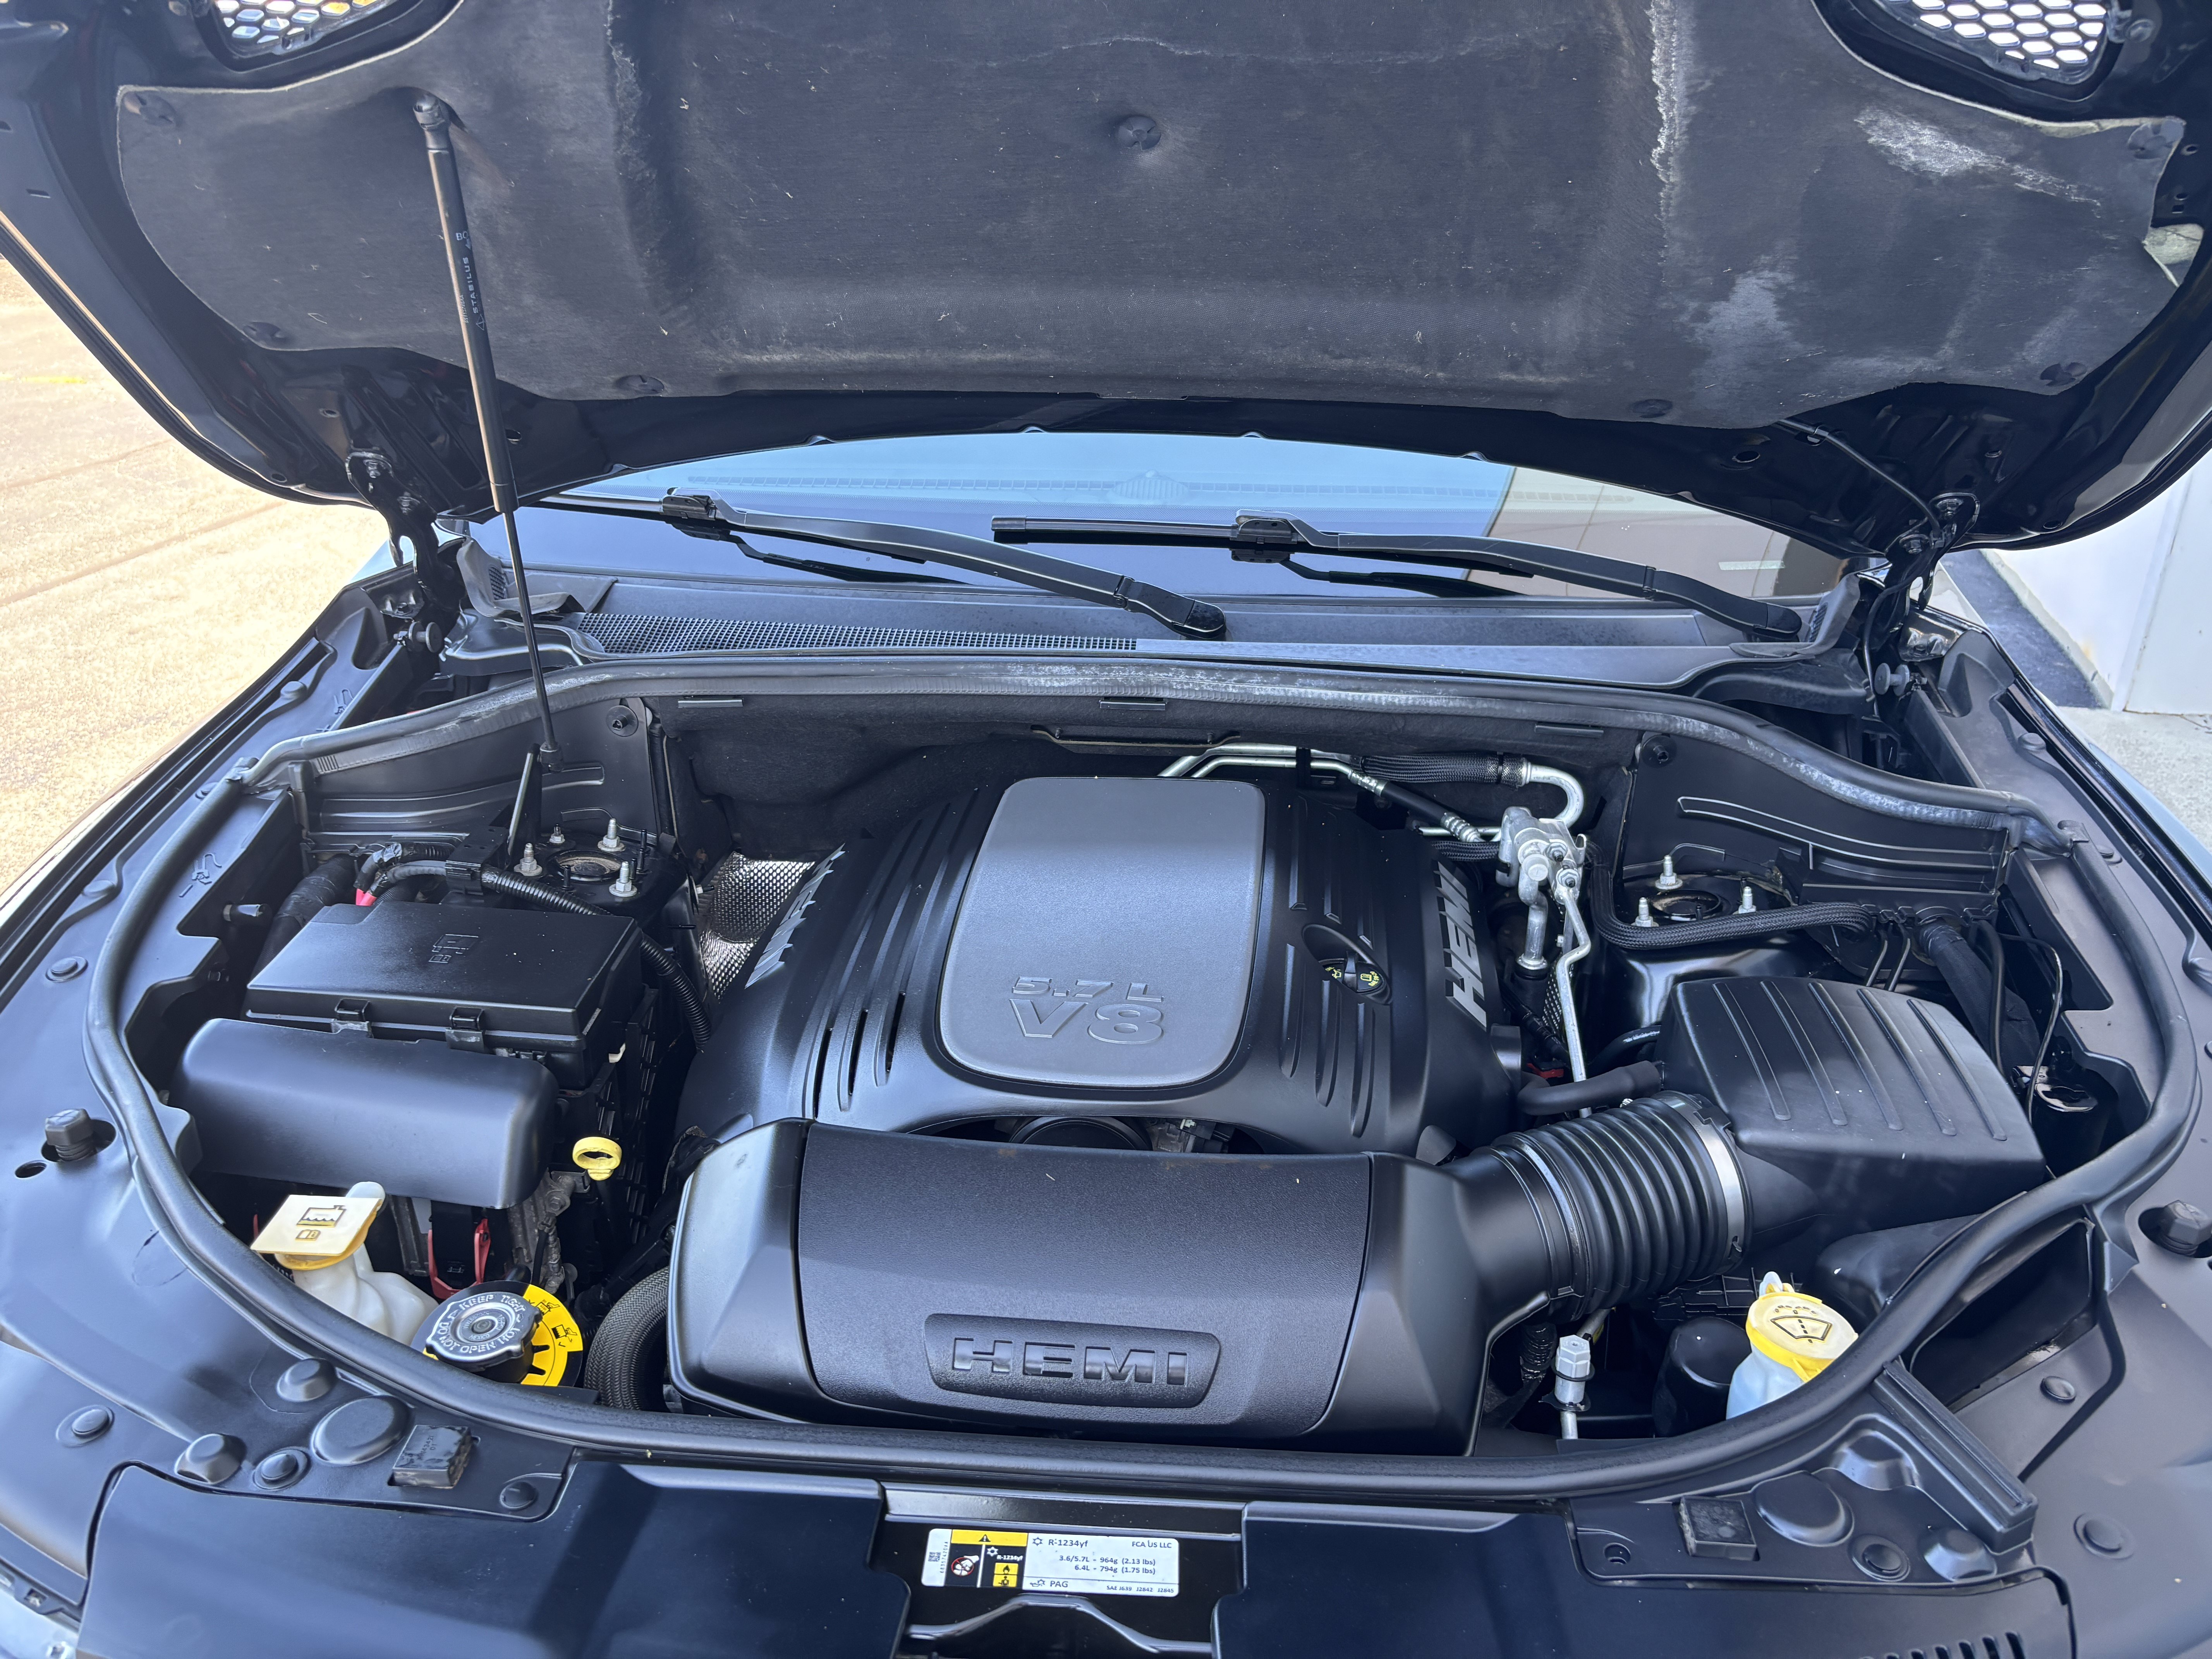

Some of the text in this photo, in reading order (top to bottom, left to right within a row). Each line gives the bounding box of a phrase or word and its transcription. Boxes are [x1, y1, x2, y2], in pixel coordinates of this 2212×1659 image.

[463, 257, 478, 314] STABILUS
[1436, 860, 1487, 1030] HEMI
[1009, 999, 1164, 1044] V8
[459, 1295, 526, 1312] KEEP TIGHT
[438, 1322, 520, 1353] DO NOT OPEN HOT
[952, 1337, 1187, 1386] HEMI
[1048, 1539, 1088, 1548] R-1234yf
